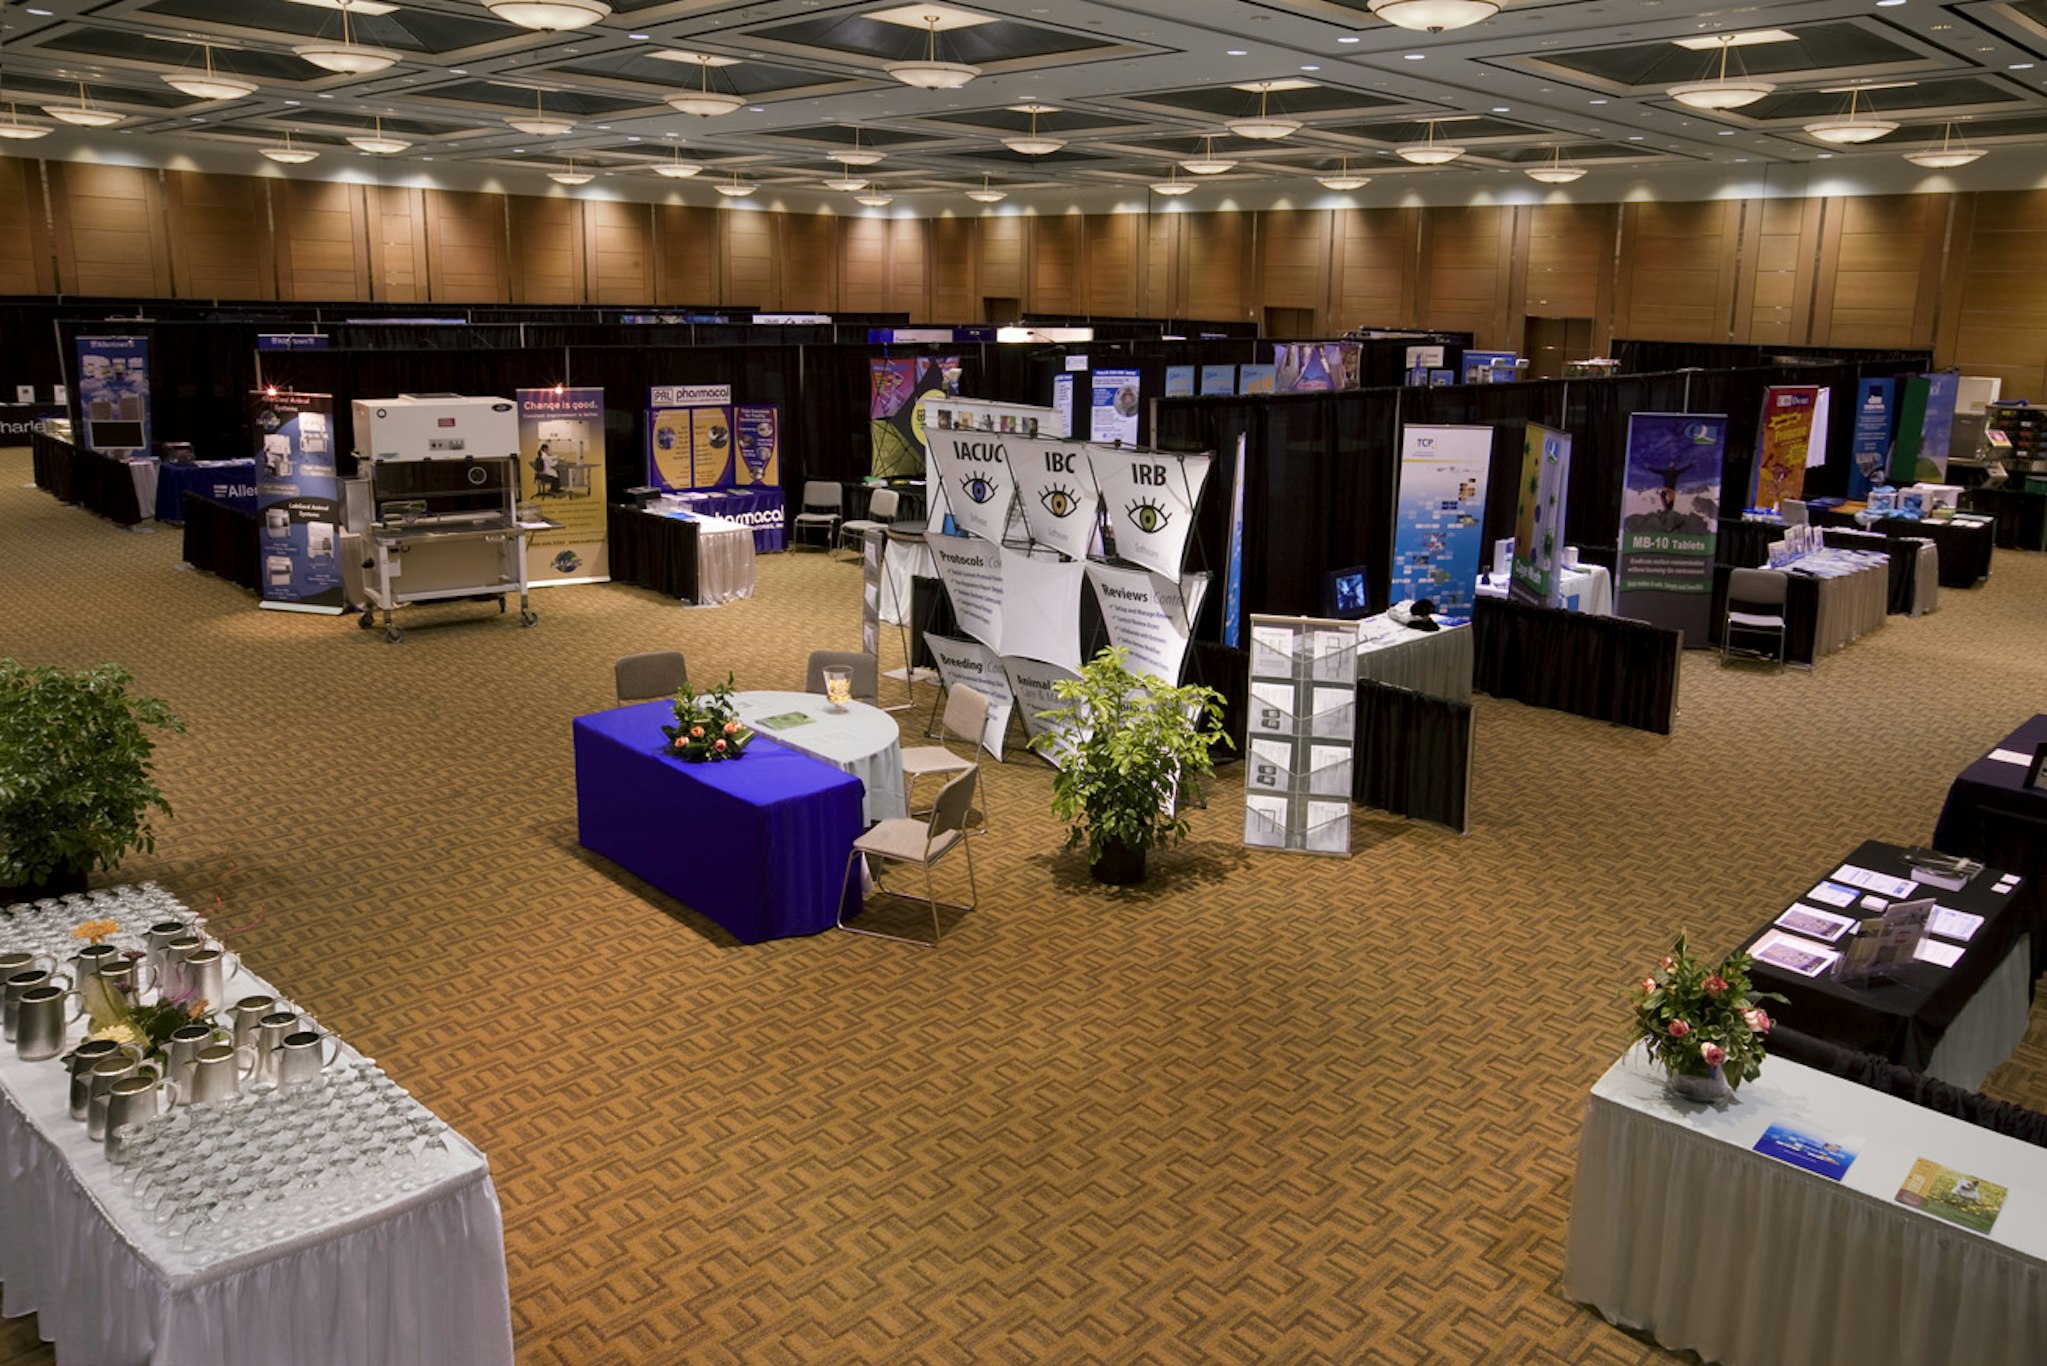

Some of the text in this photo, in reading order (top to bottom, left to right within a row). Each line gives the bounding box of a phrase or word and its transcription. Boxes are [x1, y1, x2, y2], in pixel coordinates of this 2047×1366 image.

[676, 387, 729, 402] pharmacal
[523, 400, 560, 410] Change
[571, 400, 598, 410] good.
[953, 440, 1003, 462] IACUC
[1417, 438, 1434, 448] TCP
[1045, 452, 1077, 474] IBC
[1132, 463, 1166, 486] IRB
[228, 484, 257, 498] Alle
[715, 504, 784, 525] harmacal
[1632, 536, 1705, 550] MB-10 Tablets
[939, 550, 984, 567] Protocols
[1101, 583, 1148, 602] Reviews
[940, 653, 983, 674] Breeding
[1016, 674, 1051, 690] Animal
